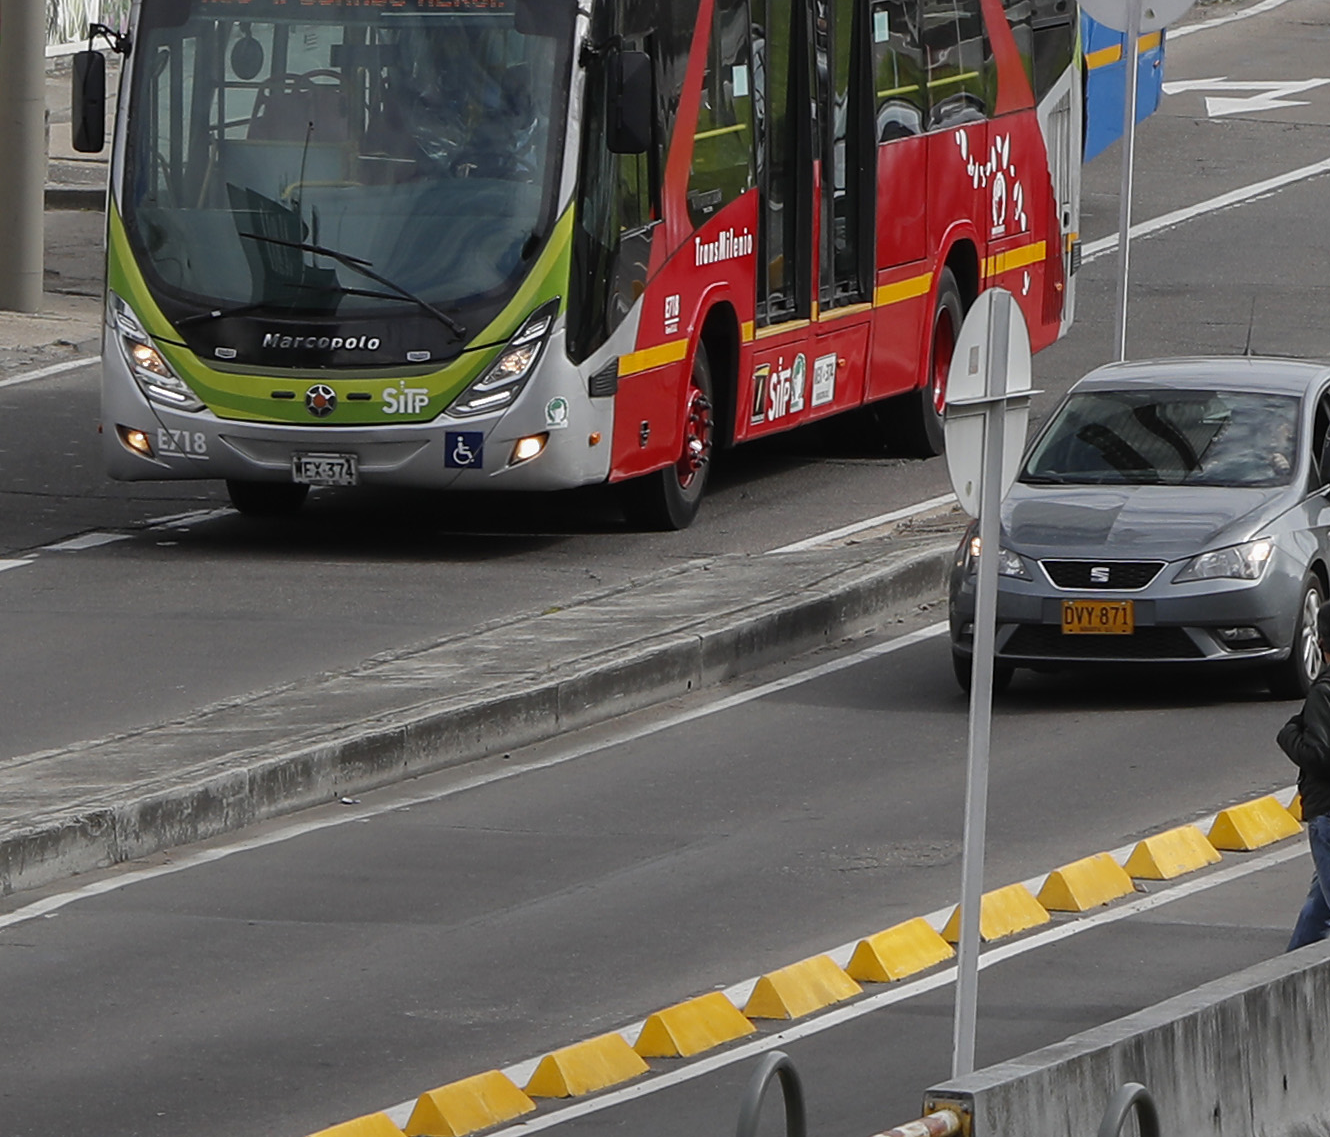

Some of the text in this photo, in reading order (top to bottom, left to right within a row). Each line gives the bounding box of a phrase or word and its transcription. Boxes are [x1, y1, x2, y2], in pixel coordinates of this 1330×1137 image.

[694, 227, 753, 267] TransMilenio
[262, 333, 381, 351] Marcopolo
[157, 427, 208, 455] E718
